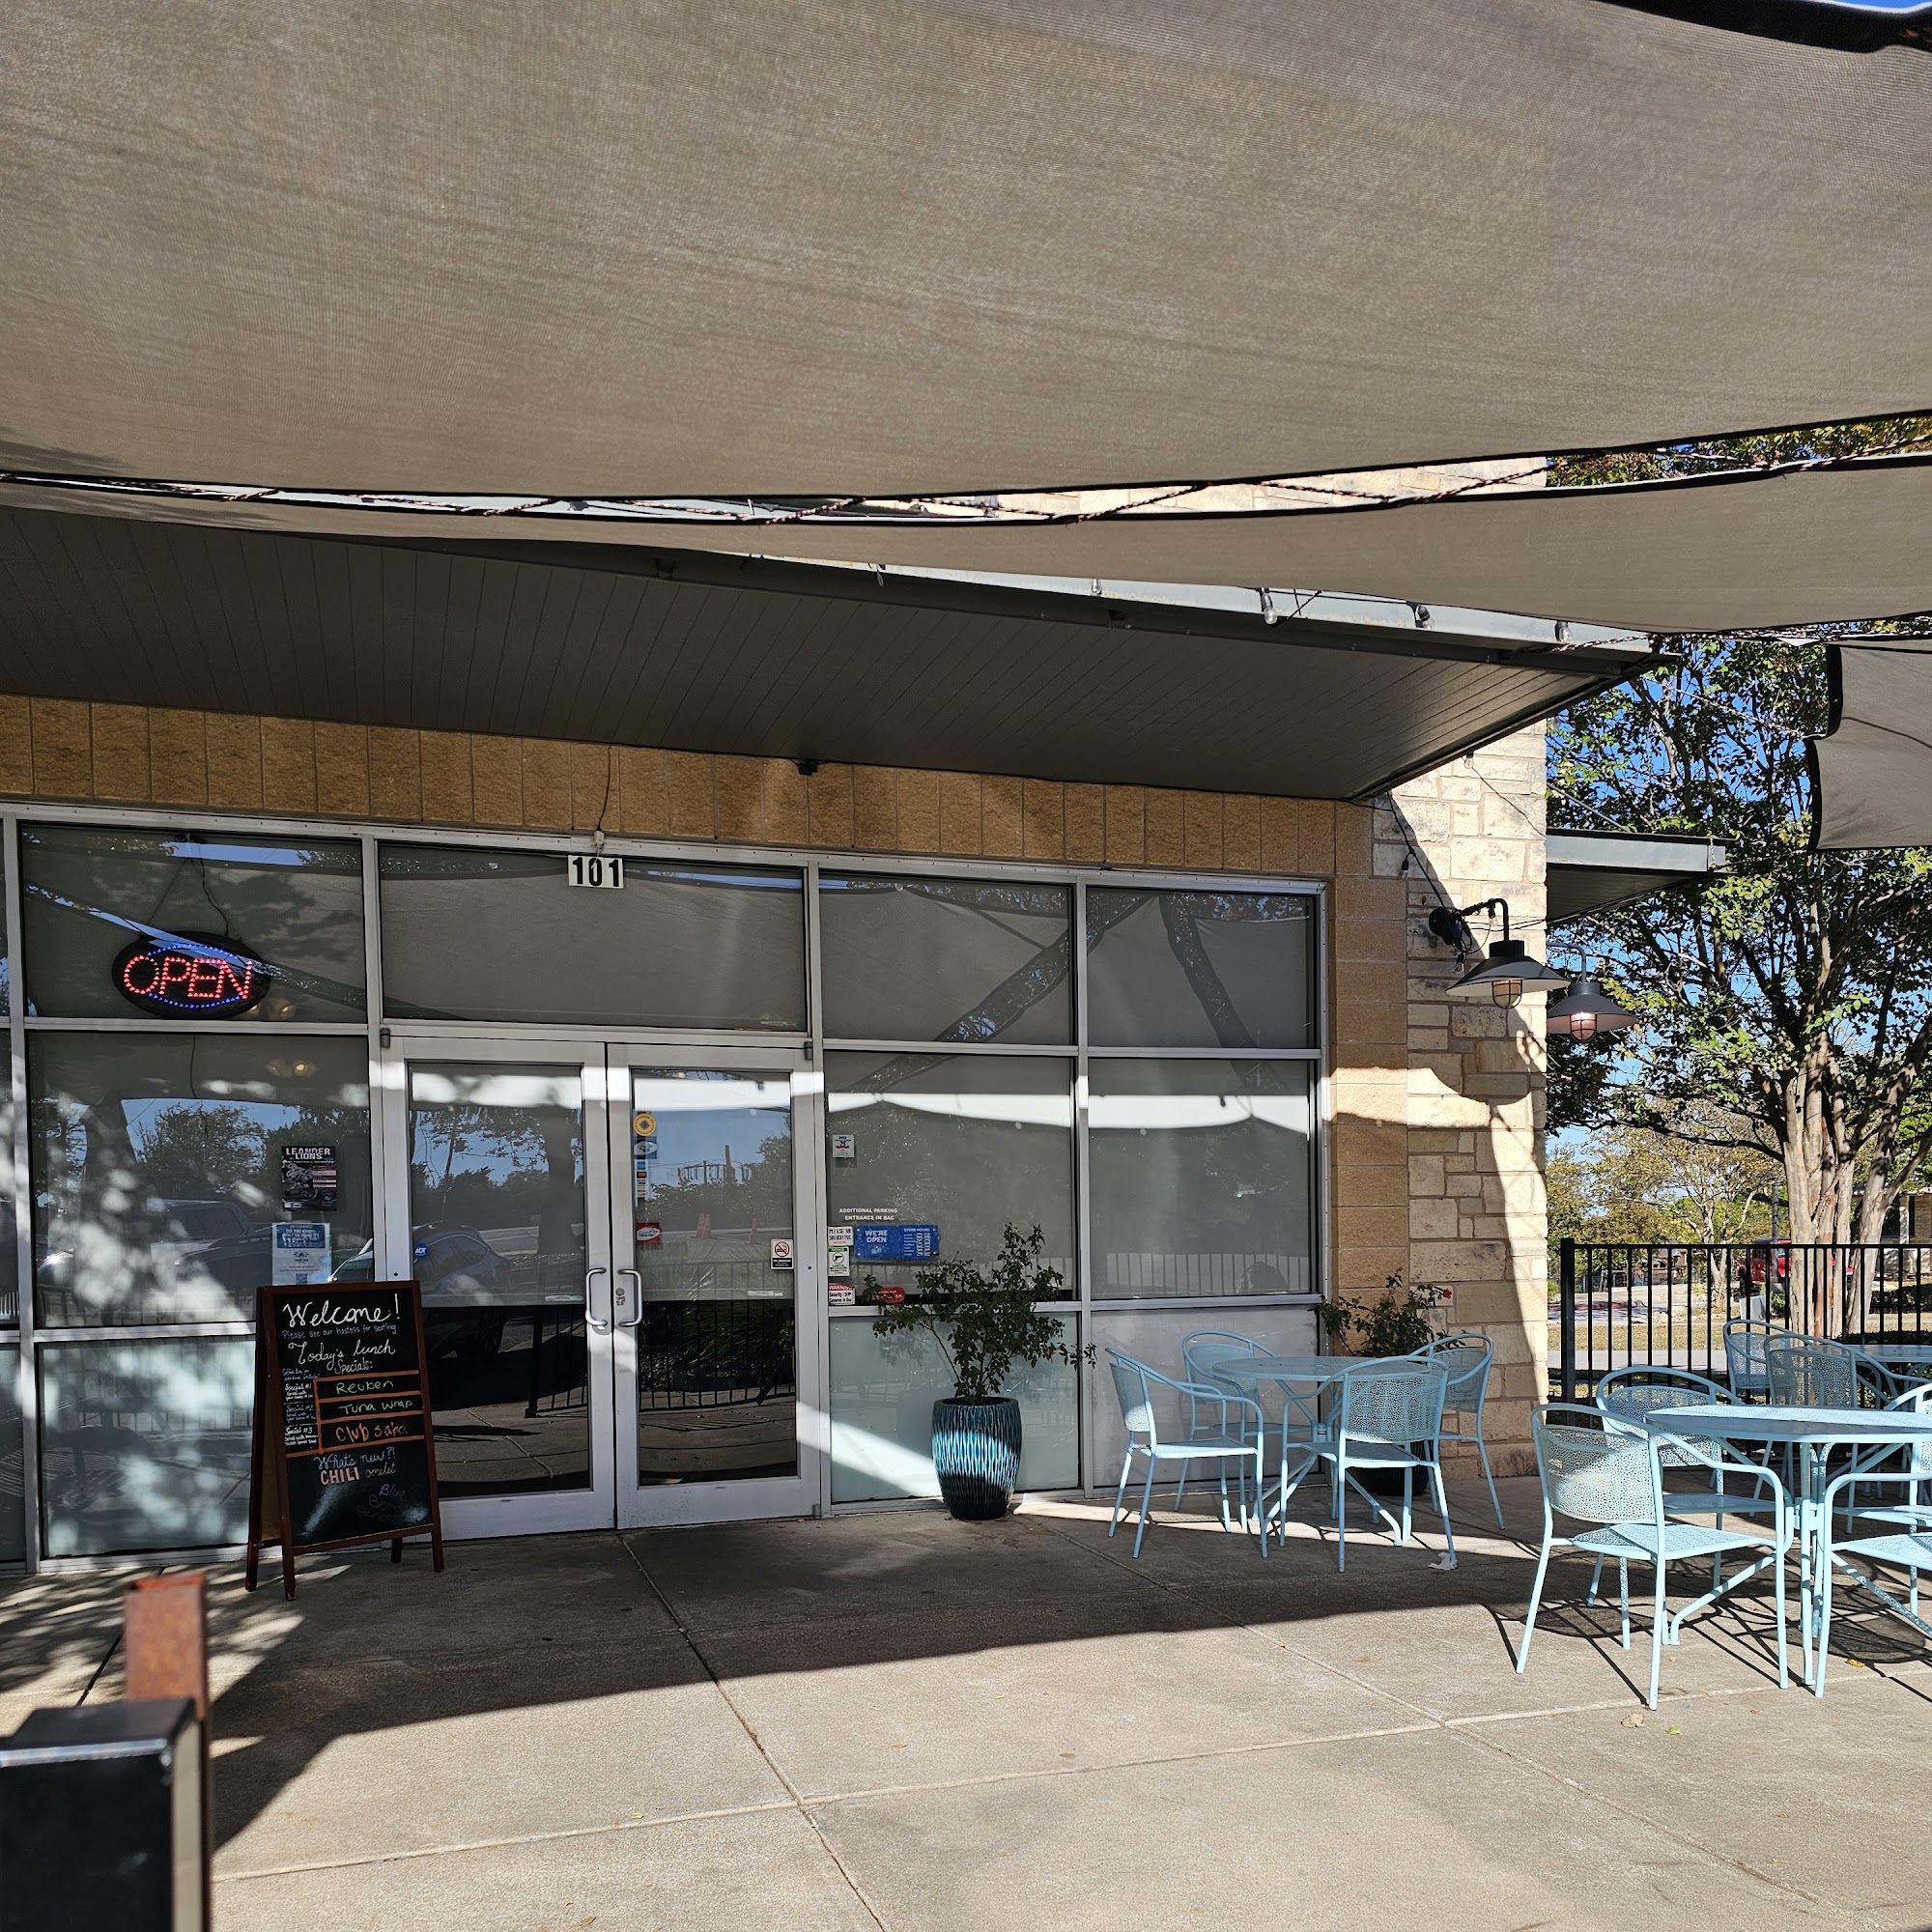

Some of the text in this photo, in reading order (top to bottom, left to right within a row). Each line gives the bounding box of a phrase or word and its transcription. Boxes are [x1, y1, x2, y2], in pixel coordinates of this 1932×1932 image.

[572, 856, 619, 888] 101
[124, 953, 253, 1000] OPEN
[285, 1147, 331, 1156] LEANDER
[281, 1329, 306, 1340] Please
[336, 1326, 360, 1335] hostess
[288, 1339, 396, 1371] Today's lunch
[334, 1356, 373, 1375] Specials:
[335, 1380, 394, 1395] Reuben
[338, 1404, 377, 1415] Tuna
[313, 1453, 357, 1470] What's
[320, 1466, 360, 1486] CHILI
